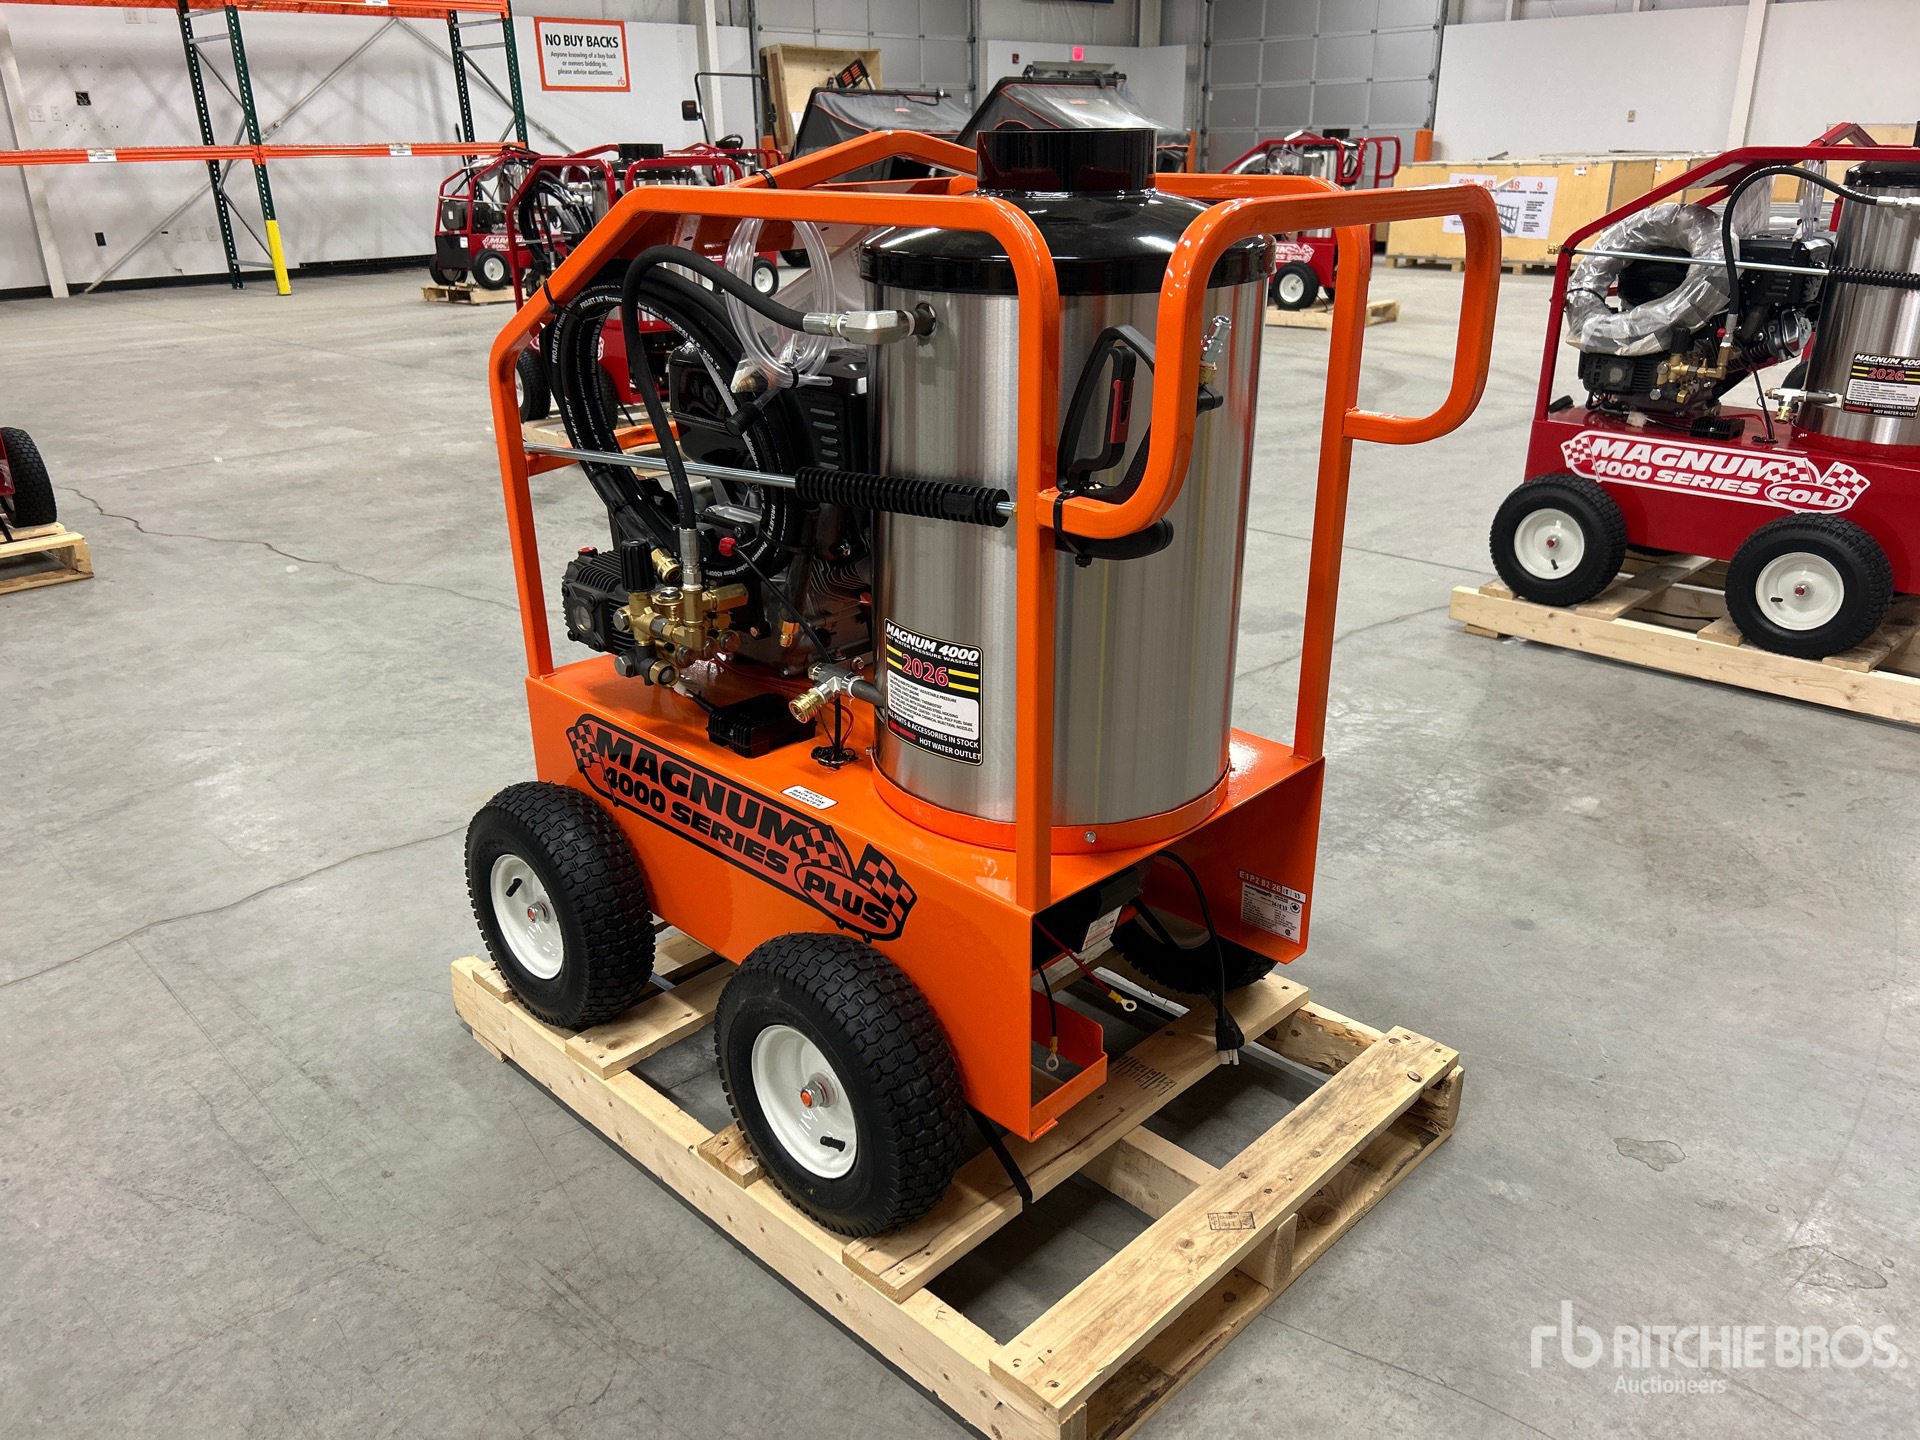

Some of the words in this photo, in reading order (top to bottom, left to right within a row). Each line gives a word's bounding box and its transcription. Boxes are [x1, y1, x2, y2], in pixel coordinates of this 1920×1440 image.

[545, 34, 561, 46] NO
[564, 34, 584, 47] BUY
[586, 36, 619, 48] BACKS
[1509, 181, 1520, 190] 48
[1537, 182, 1543, 190] 9
[1855, 354, 1900, 364] MAGNUM
[1868, 367, 1904, 381] 2026
[1591, 438, 1778, 480] MAGNUM
[1592, 460, 1652, 481] 4000
[1654, 470, 1760, 494] SERIES
[1769, 486, 1847, 508] GOLD
[886, 622, 937, 652] MAGNUM
[938, 644, 979, 662] 4000
[894, 638, 910, 650] WATER
[911, 645, 942, 659] PRESSURE
[943, 655, 978, 667] WASHERS
[902, 653, 948, 687] 2026
[911, 723, 947, 741] ACCESSORIES
[956, 738, 978, 748] STOCK
[920, 737, 930, 747] HOT
[932, 742, 953, 754] WATER
[954, 748, 981, 760] OUTLET
[596, 727, 812, 854] MAGNUM
[602, 766, 666, 814] 4000
[670, 803, 790, 874] SERIES
[804, 870, 890, 930] PLUS
